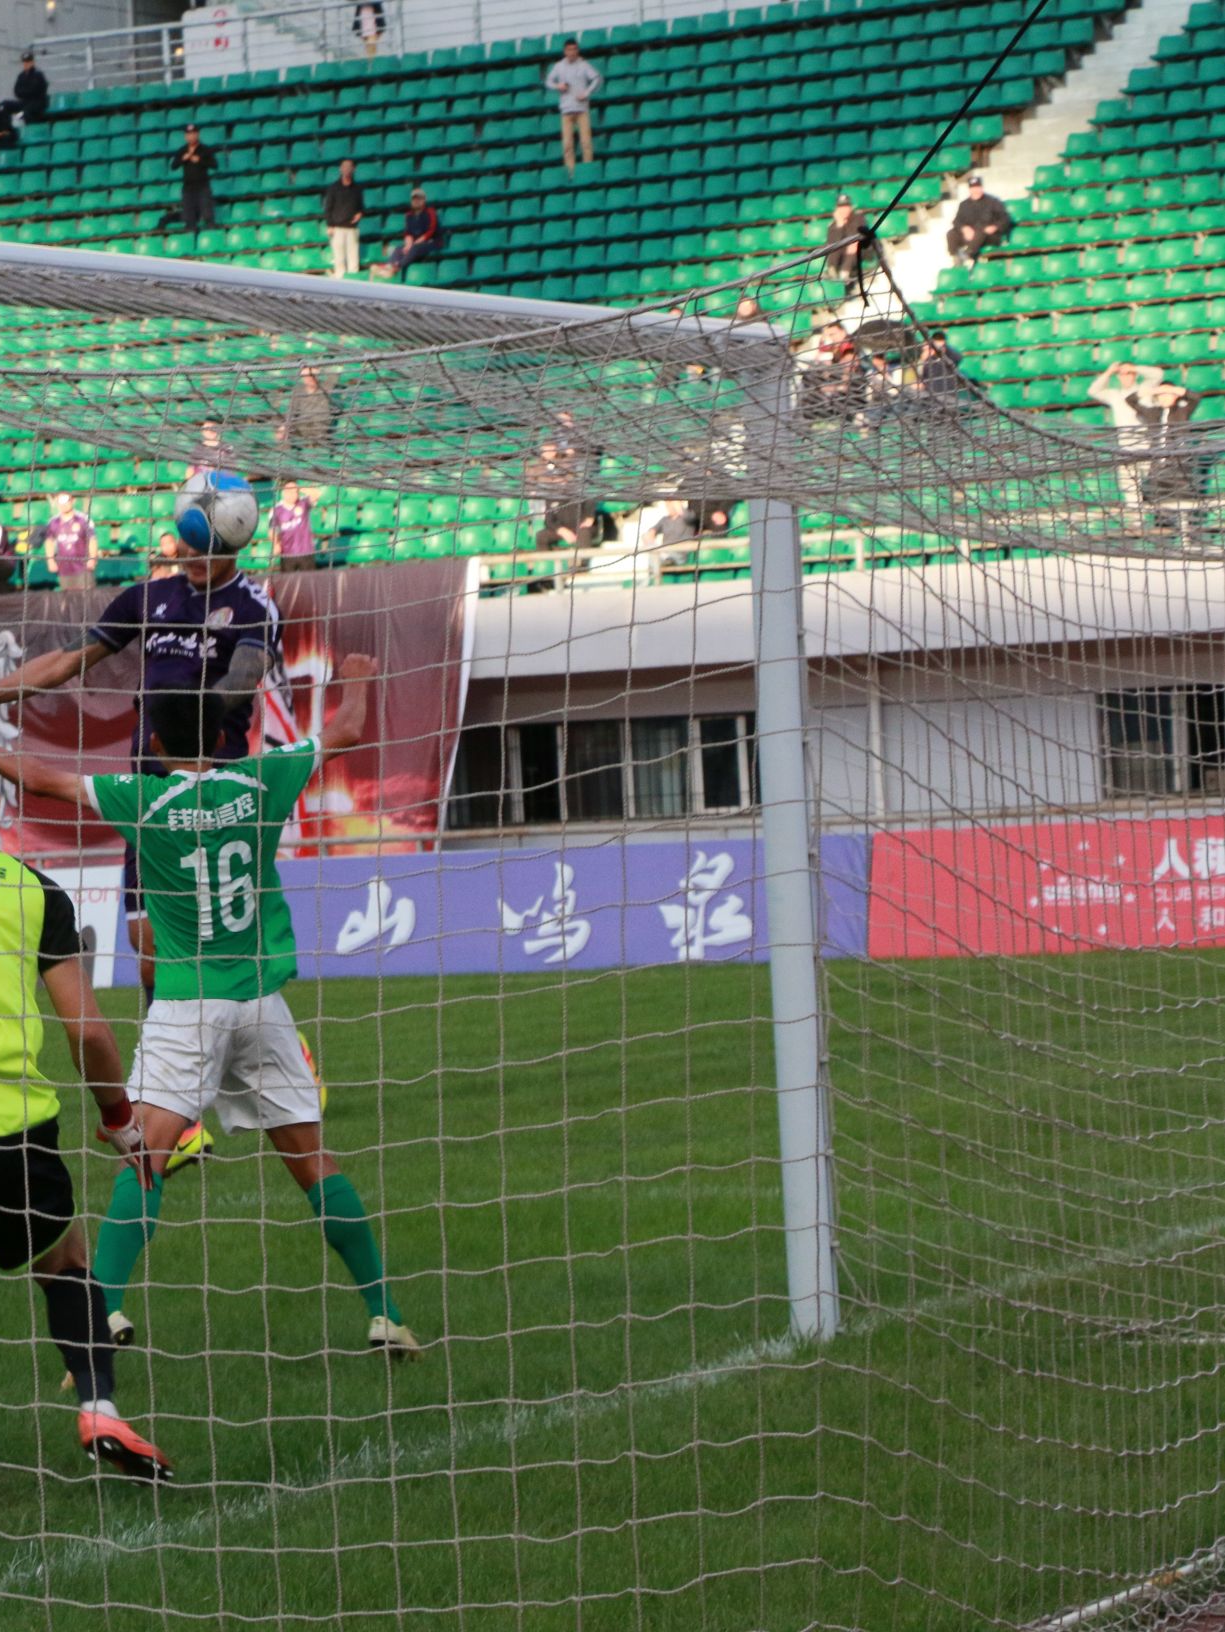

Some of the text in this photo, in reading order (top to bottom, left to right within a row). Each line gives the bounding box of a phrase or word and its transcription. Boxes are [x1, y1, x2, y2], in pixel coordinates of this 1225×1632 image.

[167, 792, 256, 831] 钱旺信控
[180, 840, 256, 941] 16
